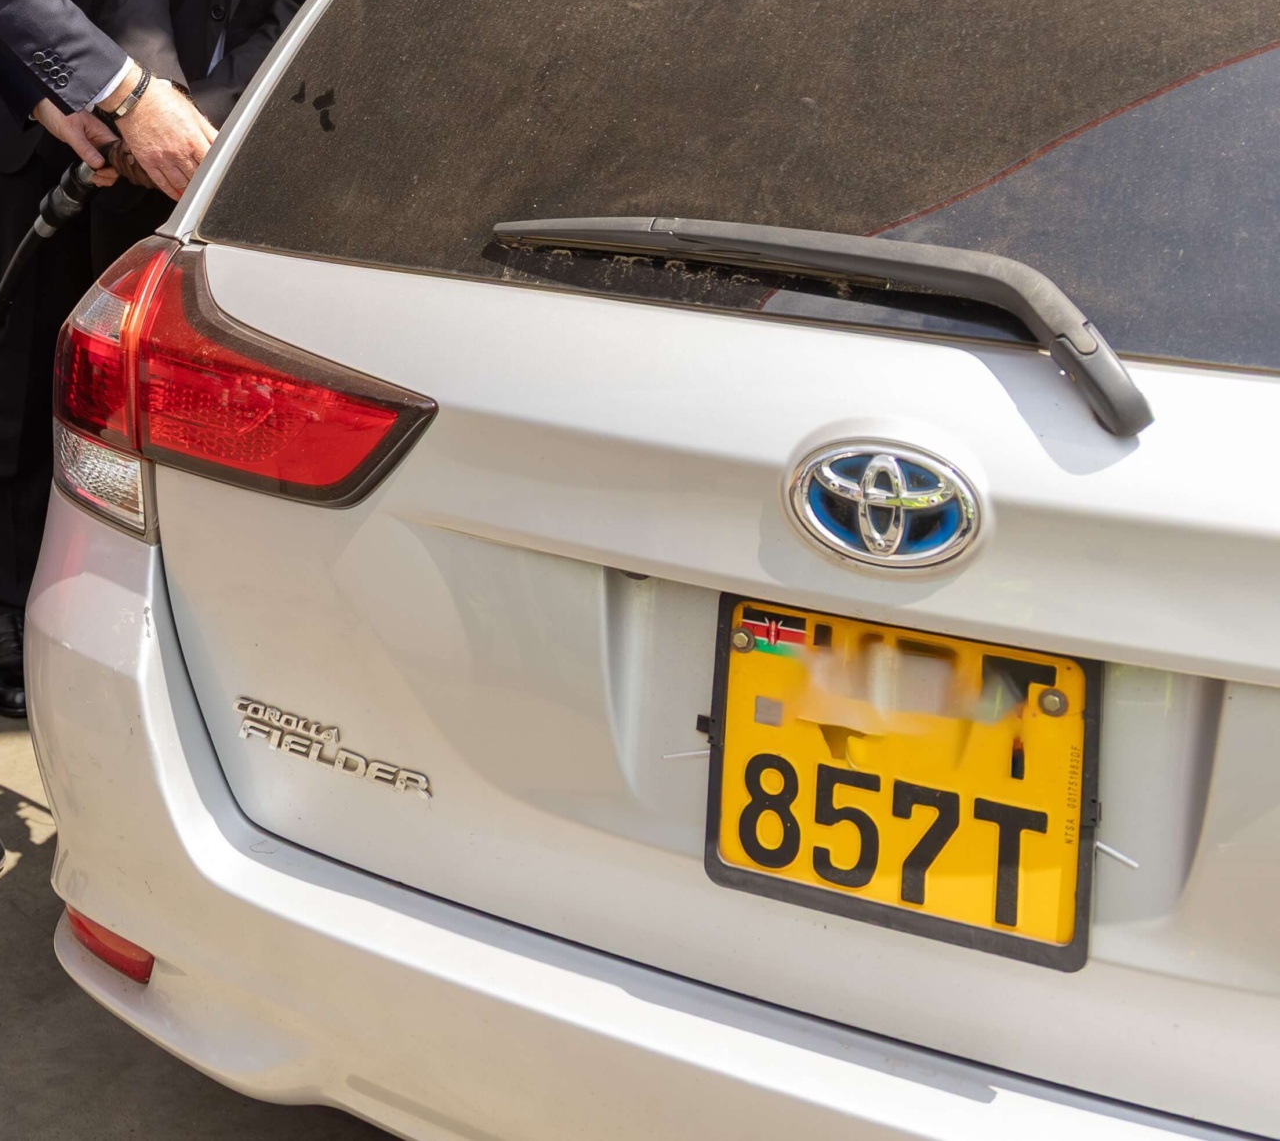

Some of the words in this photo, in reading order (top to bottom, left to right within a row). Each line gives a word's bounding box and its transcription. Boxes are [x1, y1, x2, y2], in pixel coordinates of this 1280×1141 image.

[232, 696, 341, 744] COROLLA
[238, 716, 432, 800] FIELDER
[738, 753, 1048, 927] 857T
[1064, 819, 1075, 845] NTSA
